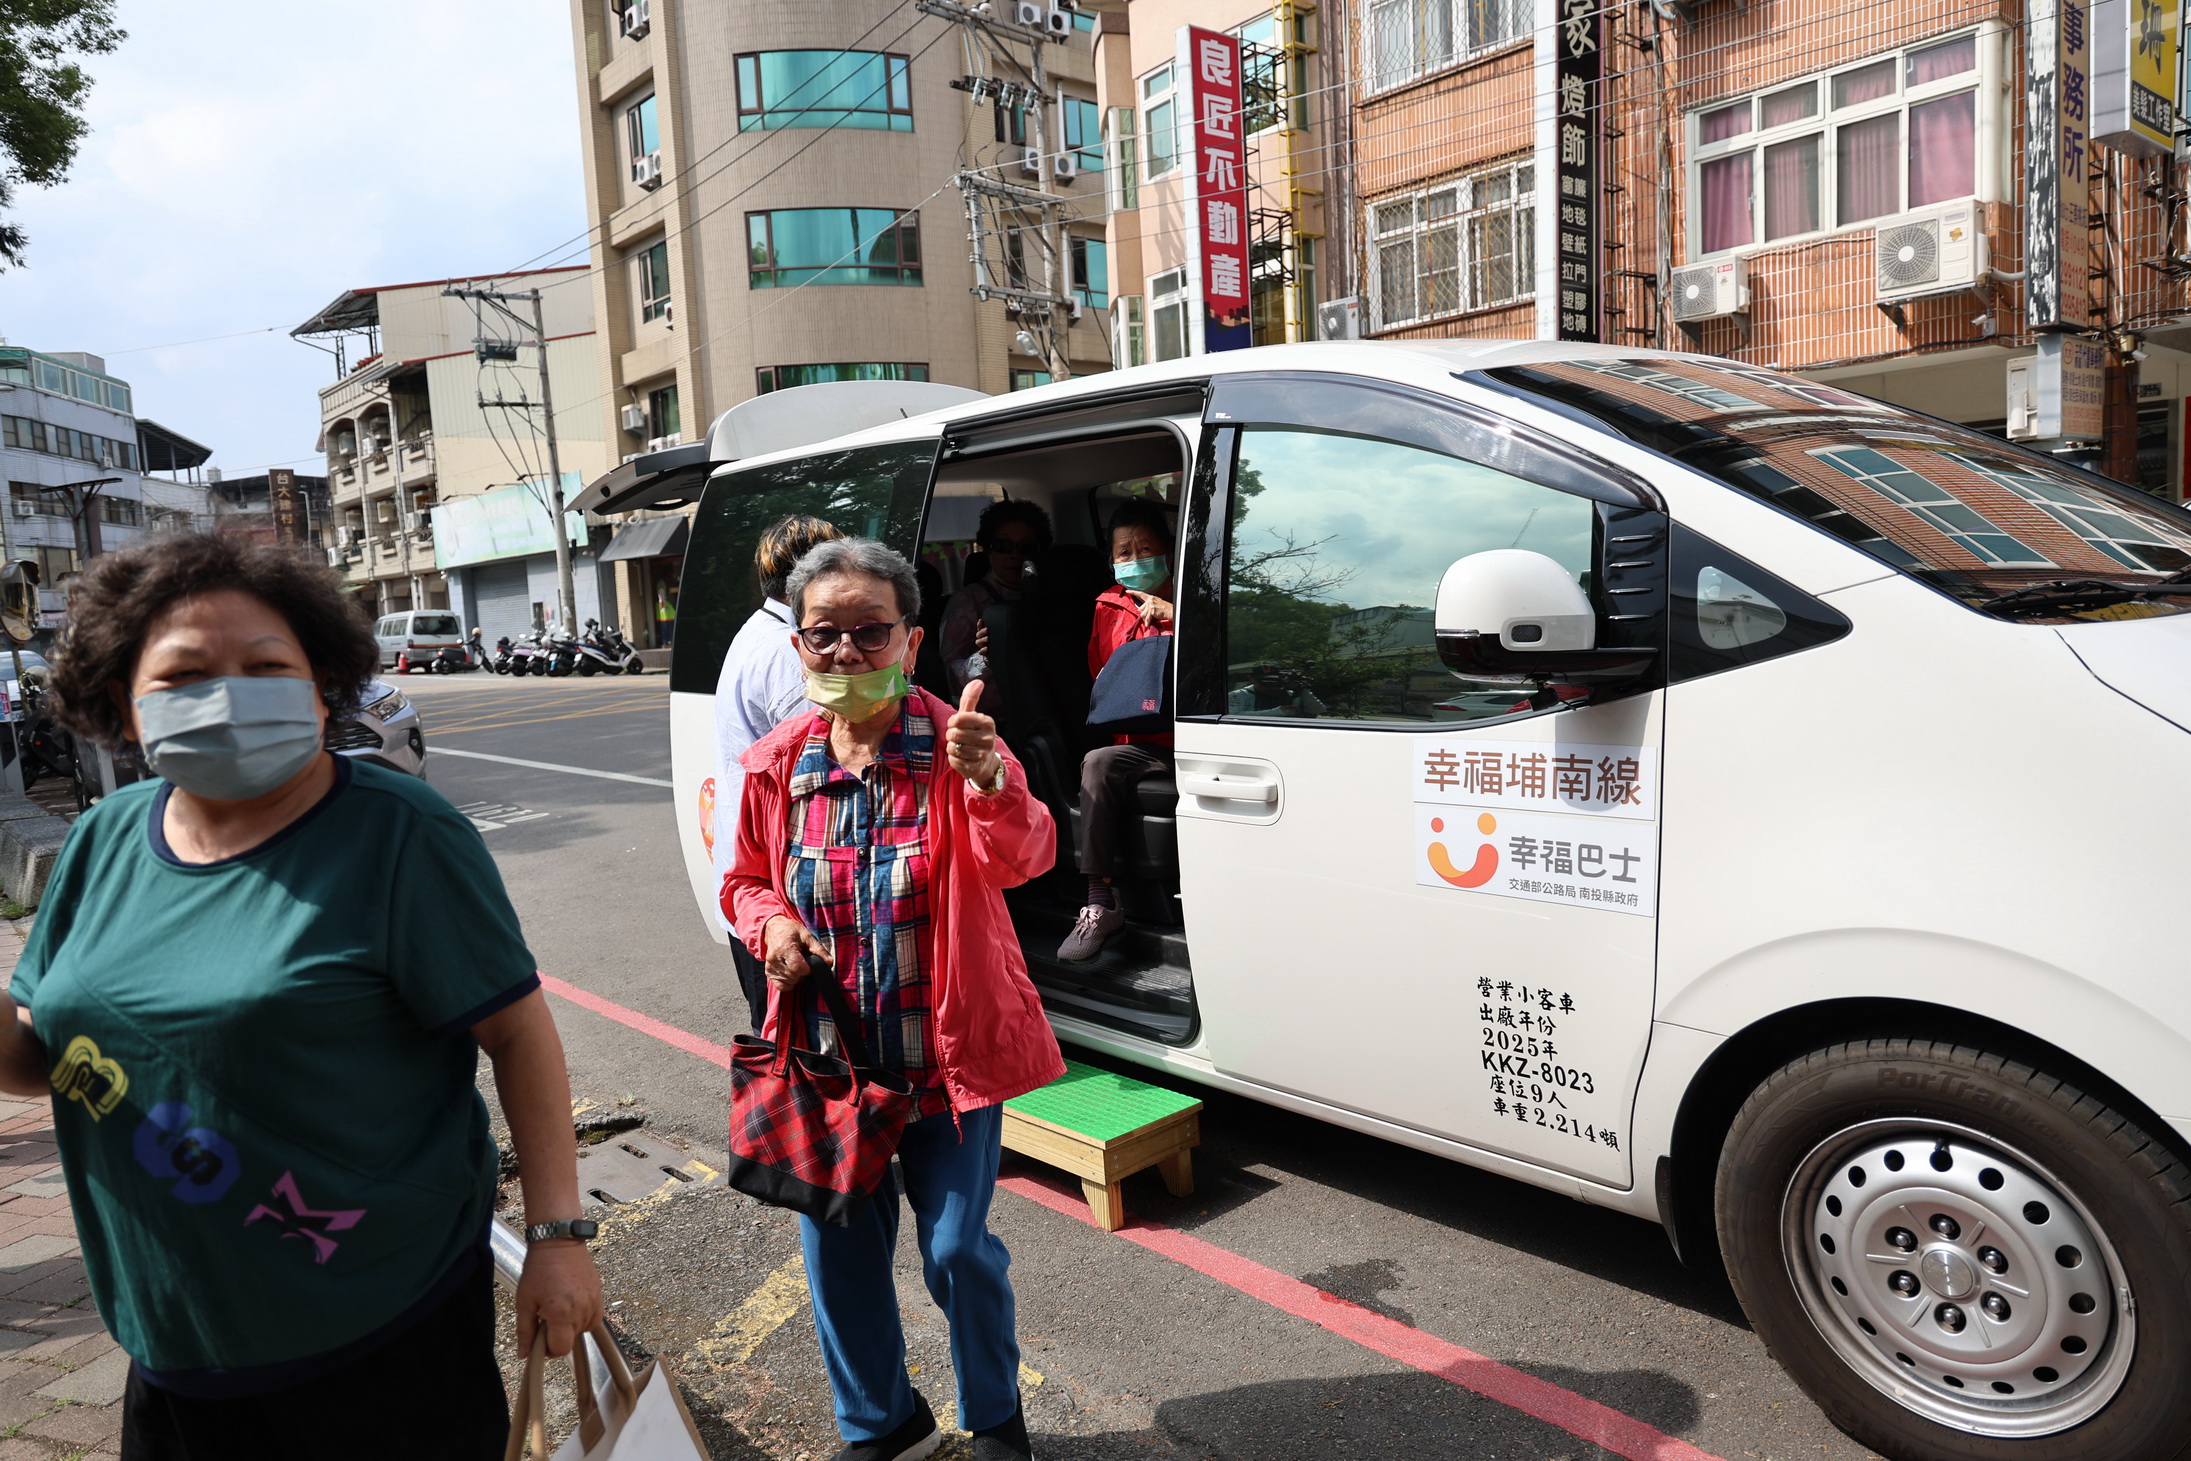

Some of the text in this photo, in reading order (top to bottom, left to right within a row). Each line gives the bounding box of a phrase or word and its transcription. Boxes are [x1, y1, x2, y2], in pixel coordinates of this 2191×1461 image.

[2062, 0, 2085, 184] 事務所
[1561, 72, 1586, 167] 燈飾
[1200, 38, 1242, 299] 良匠不動產
[1561, 175, 1587, 198] 窗簾
[1561, 203, 1587, 226] 地毯
[1561, 232, 1587, 255] 壁紙
[1561, 261, 1587, 283] 拉門
[1562, 290, 1587, 311] 塑膠
[1562, 311, 1587, 333] 地磚
[1424, 748, 1642, 806] 幸福埔南線
[1508, 835, 1641, 884] 幸福巴士
[1508, 878, 1639, 907] 交通部公路局 南投縣政府
[1477, 976, 1576, 1015] 營業小客車
[1479, 1002, 1557, 1036] 出廠年份
[1482, 1027, 1558, 1061] 2025年
[1481, 1049, 1595, 1094] KKZ-8023
[1489, 1074, 1568, 1110] 座位9人
[1493, 1096, 1620, 1152] 車重2.214噸
